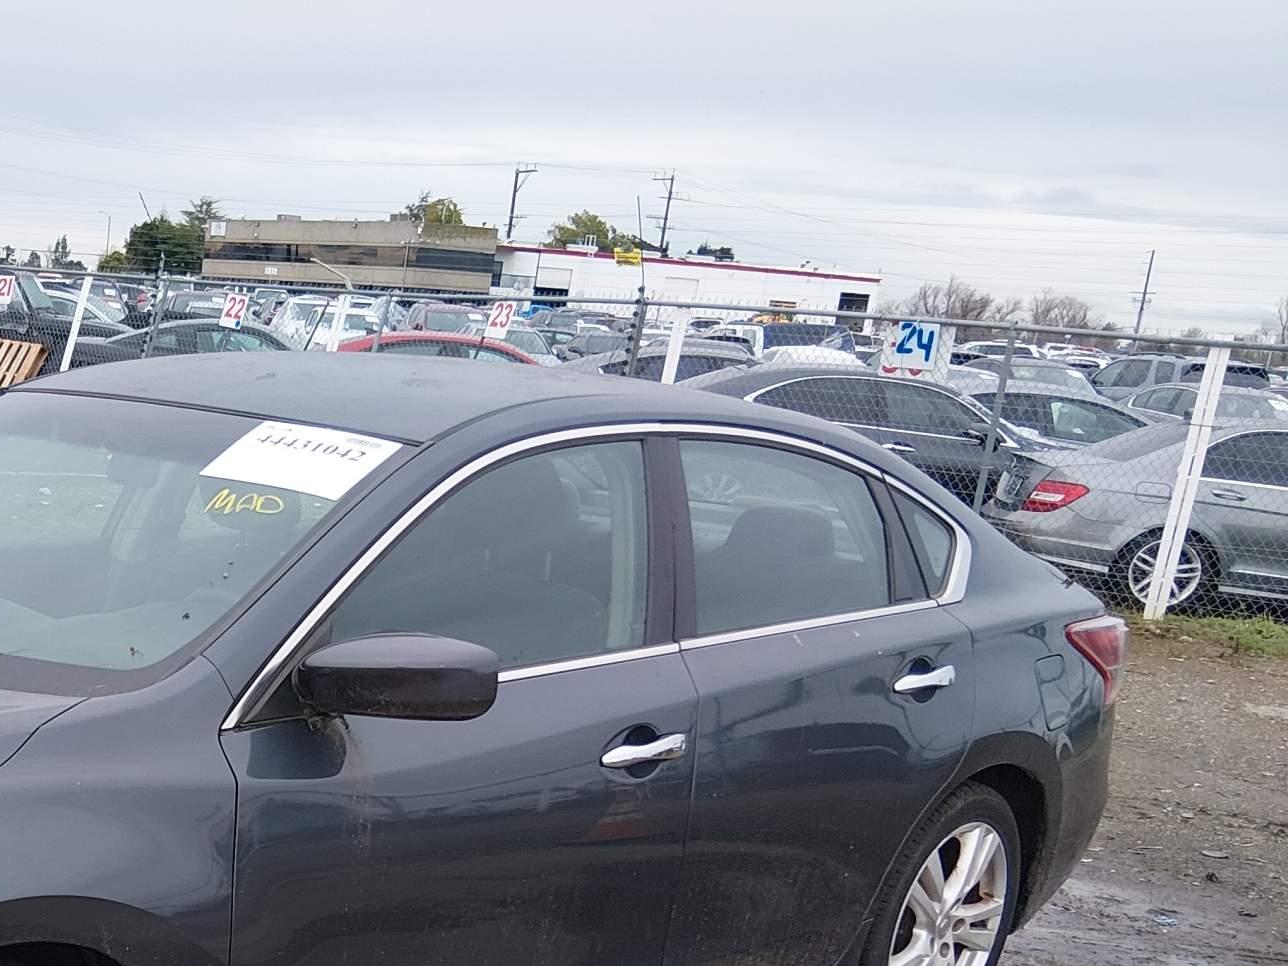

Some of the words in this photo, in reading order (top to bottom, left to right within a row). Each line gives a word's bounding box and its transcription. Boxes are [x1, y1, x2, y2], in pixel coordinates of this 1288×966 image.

[224, 297, 245, 320] 22
[490, 303, 513, 328] 23
[896, 322, 935, 362] 24
[257, 434, 367, 461] 44431042
